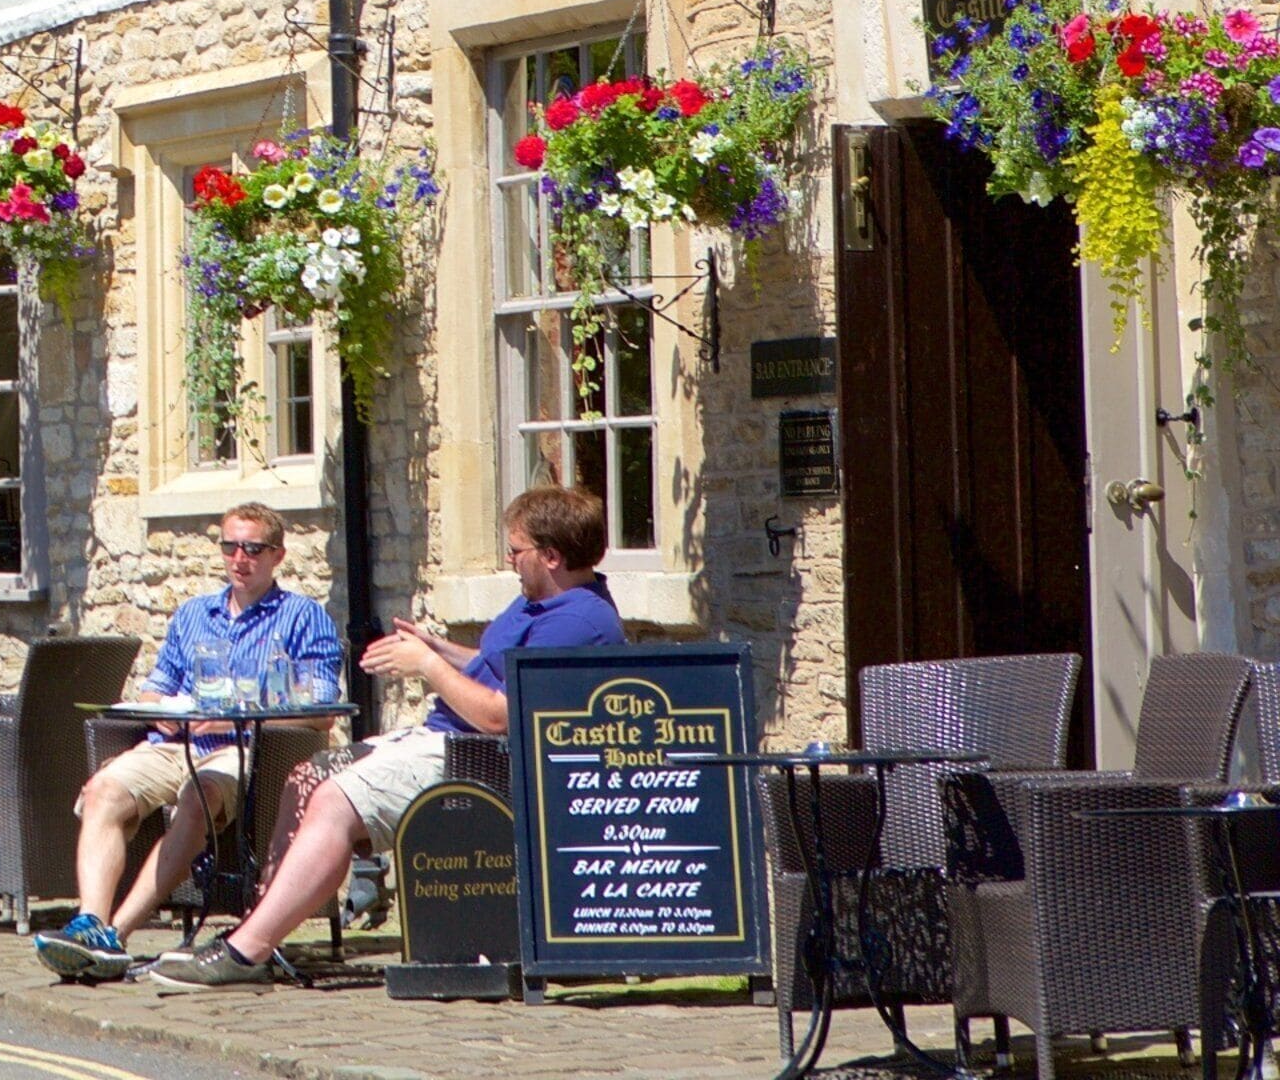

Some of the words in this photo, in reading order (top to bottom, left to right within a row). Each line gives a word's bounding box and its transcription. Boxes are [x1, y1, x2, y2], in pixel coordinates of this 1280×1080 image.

[755, 361, 776, 379] BAR
[777, 357, 832, 377] ENTRANCE
[603, 694, 656, 718] The
[546, 721, 642, 746] Castle
[654, 718, 716, 744] Inn
[603, 747, 665, 769] Hotel
[567, 772, 600, 789] TEA
[607, 771, 623, 789] &
[630, 770, 701, 789] COFFEE
[569, 797, 640, 815] SERVED
[645, 796, 700, 814] FROM
[603, 824, 667, 841] 9.30am
[413, 852, 469, 871] Cream
[474, 850, 512, 869] Teas
[572, 859, 616, 875] BAR
[620, 859, 681, 875] MENU
[685, 862, 708, 875] or
[414, 879, 459, 901] being
[463, 877, 517, 896] served
[581, 882, 596, 898] A
[603, 882, 628, 898] LA
[636, 881, 701, 898] CARTE
[573, 907, 613, 918] LUNCH
[657, 907, 672, 918] TO
[673, 907, 712, 920] 3.00pm
[574, 922, 618, 933] DINNER
[619, 922, 658, 935] 6.00pm
[661, 922, 676, 933] TO
